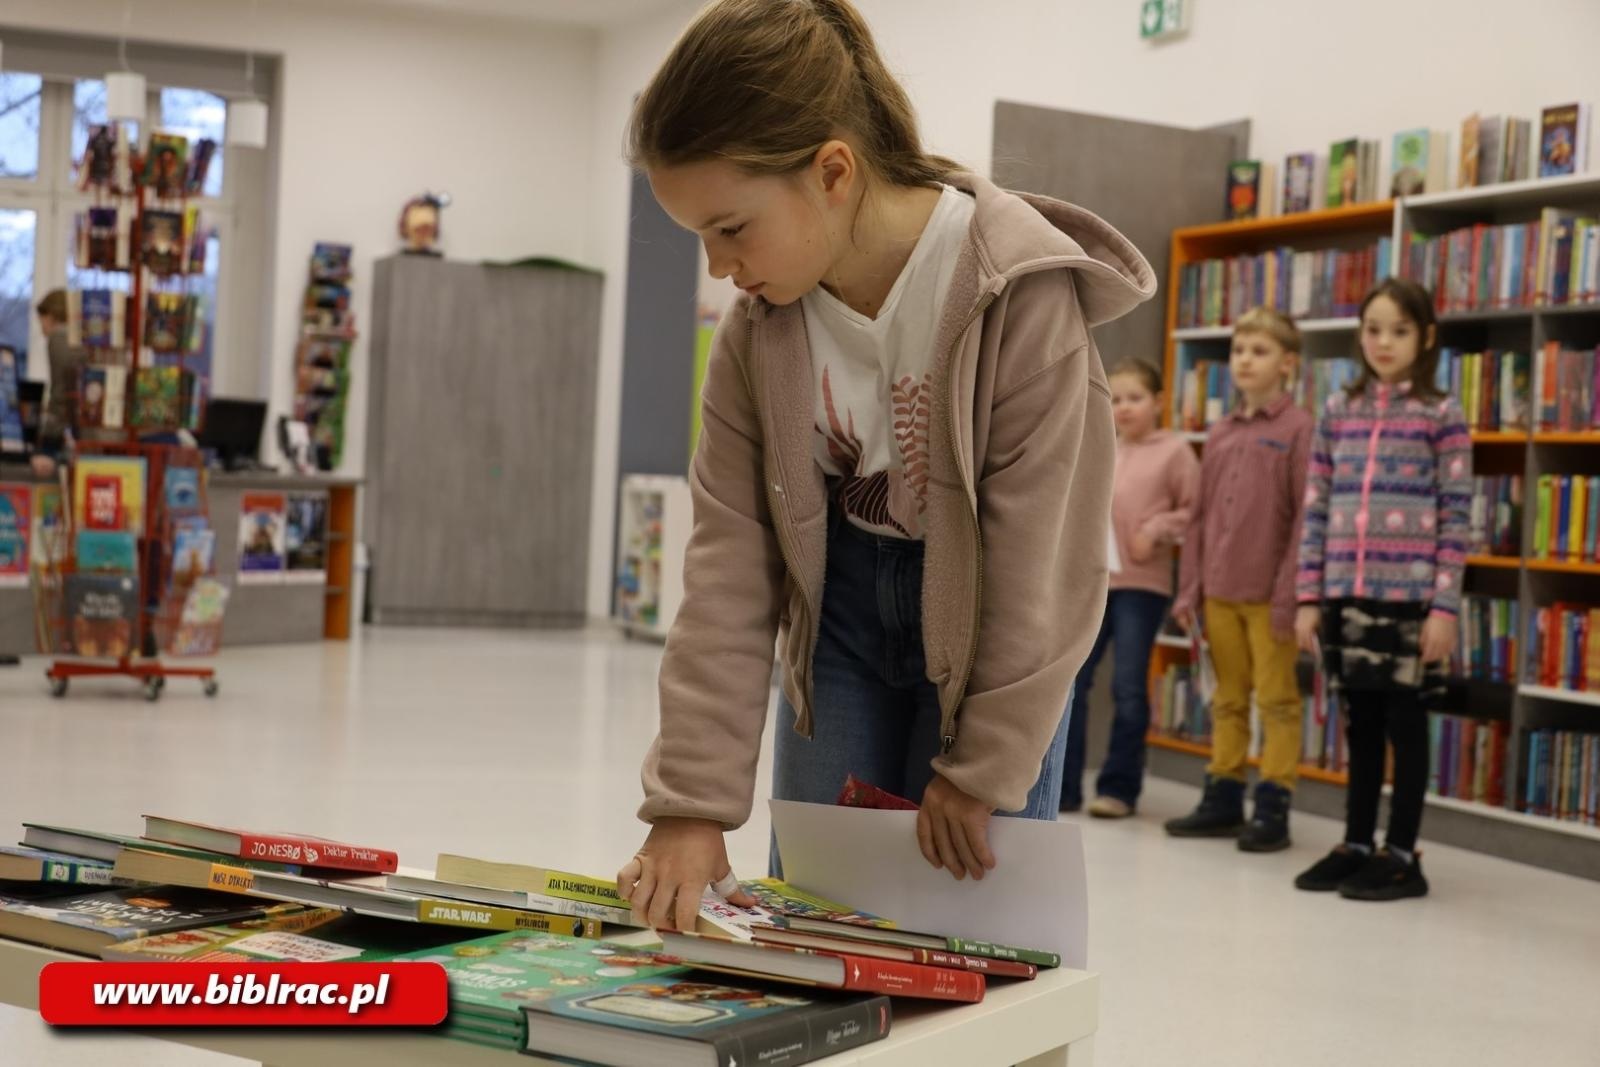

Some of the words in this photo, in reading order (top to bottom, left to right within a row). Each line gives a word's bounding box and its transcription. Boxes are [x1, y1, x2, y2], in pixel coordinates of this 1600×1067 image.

[251, 842, 266, 856] JO
[268, 843, 301, 860] NESBØ
[323, 845, 348, 858] Doktor
[351, 846, 379, 862] Proktor
[548, 879, 561, 890] ATAK
[429, 906, 461, 920] STAR
[461, 909, 492, 924] WARS
